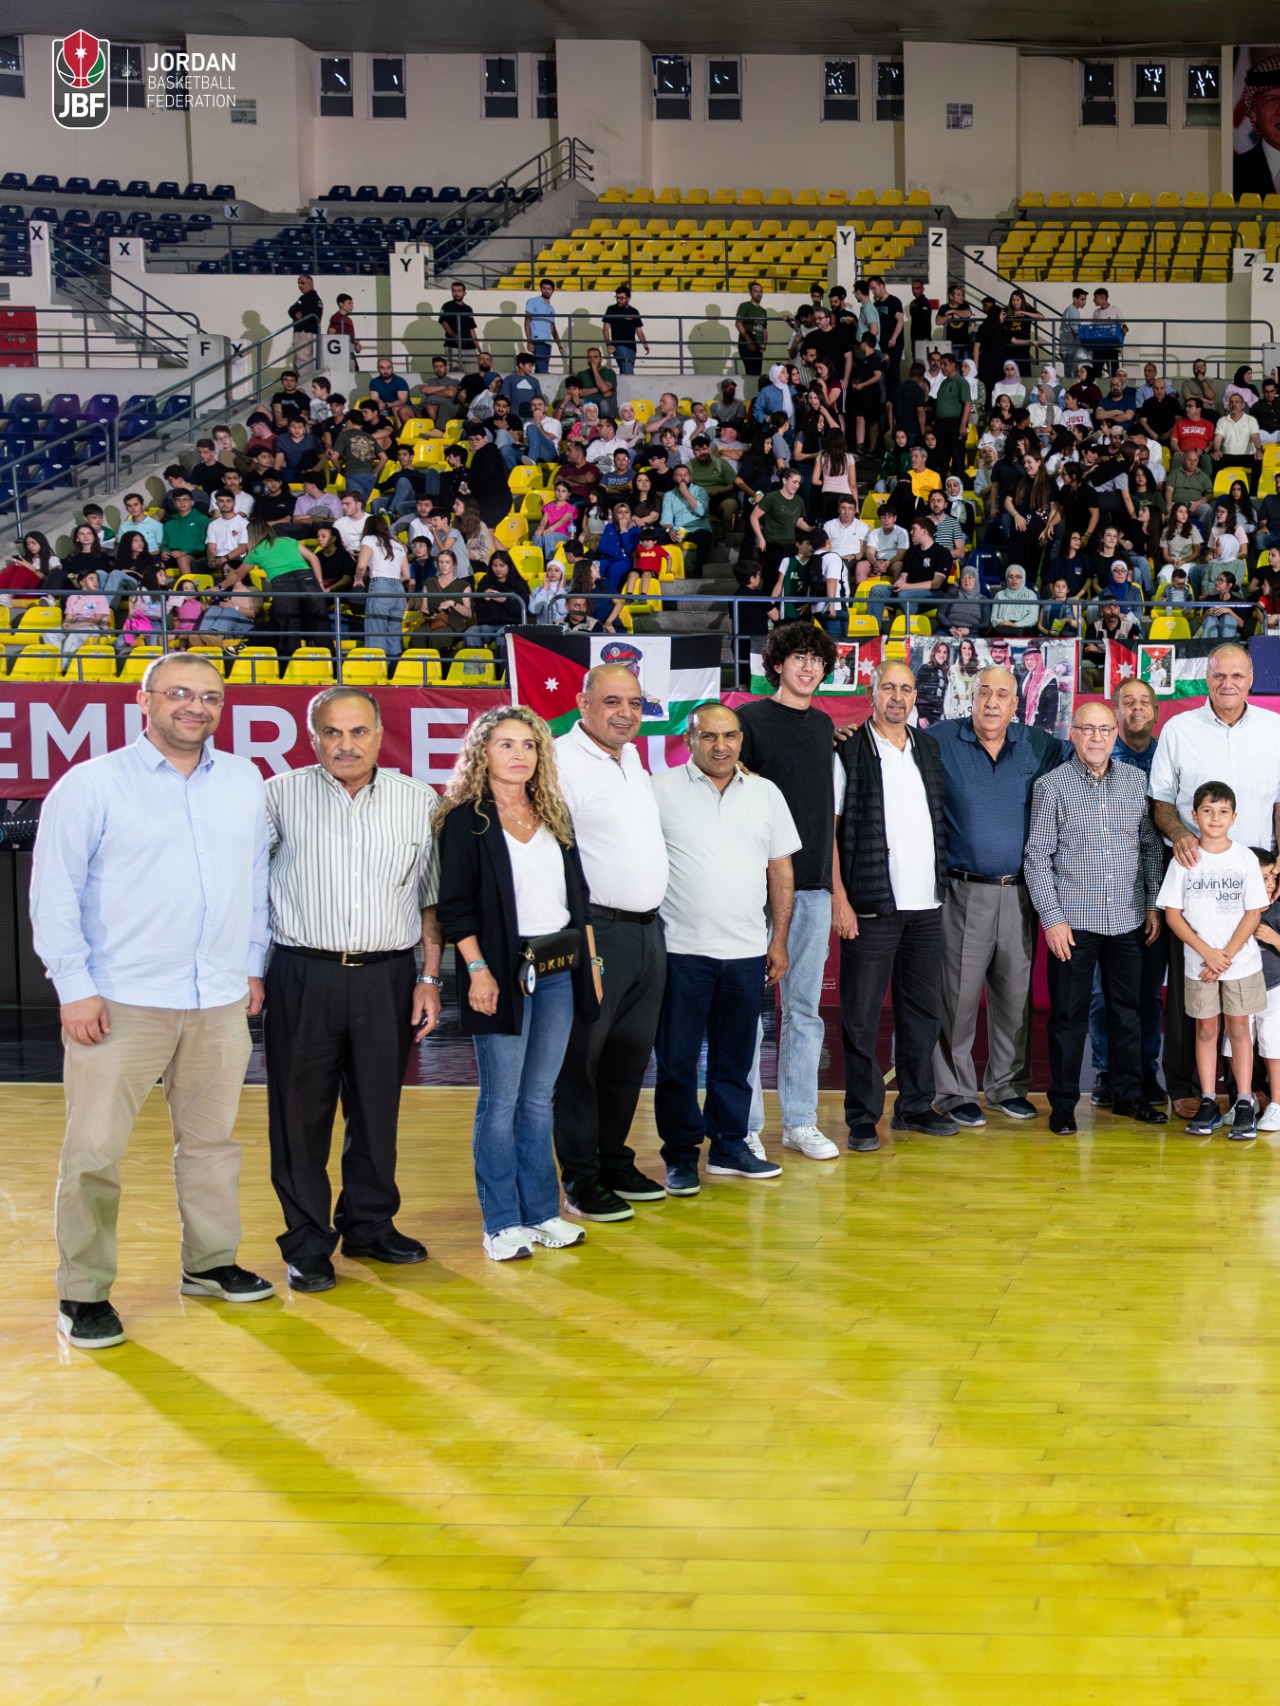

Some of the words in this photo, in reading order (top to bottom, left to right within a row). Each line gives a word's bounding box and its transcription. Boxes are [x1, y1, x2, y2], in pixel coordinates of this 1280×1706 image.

[229, 206, 238, 218] X
[934, 208, 943, 220] Y
[32, 226, 43, 240] X
[840, 231, 851, 245] Y
[932, 231, 942, 247] Z
[119, 242, 130, 255] X
[400, 258, 412, 272] Y
[1244, 253, 1255, 267] Z
[1263, 268, 1274, 282] Z
[200, 342, 210, 356] F
[327, 340, 341, 354] G
[539, 954, 575, 973] DKNY
